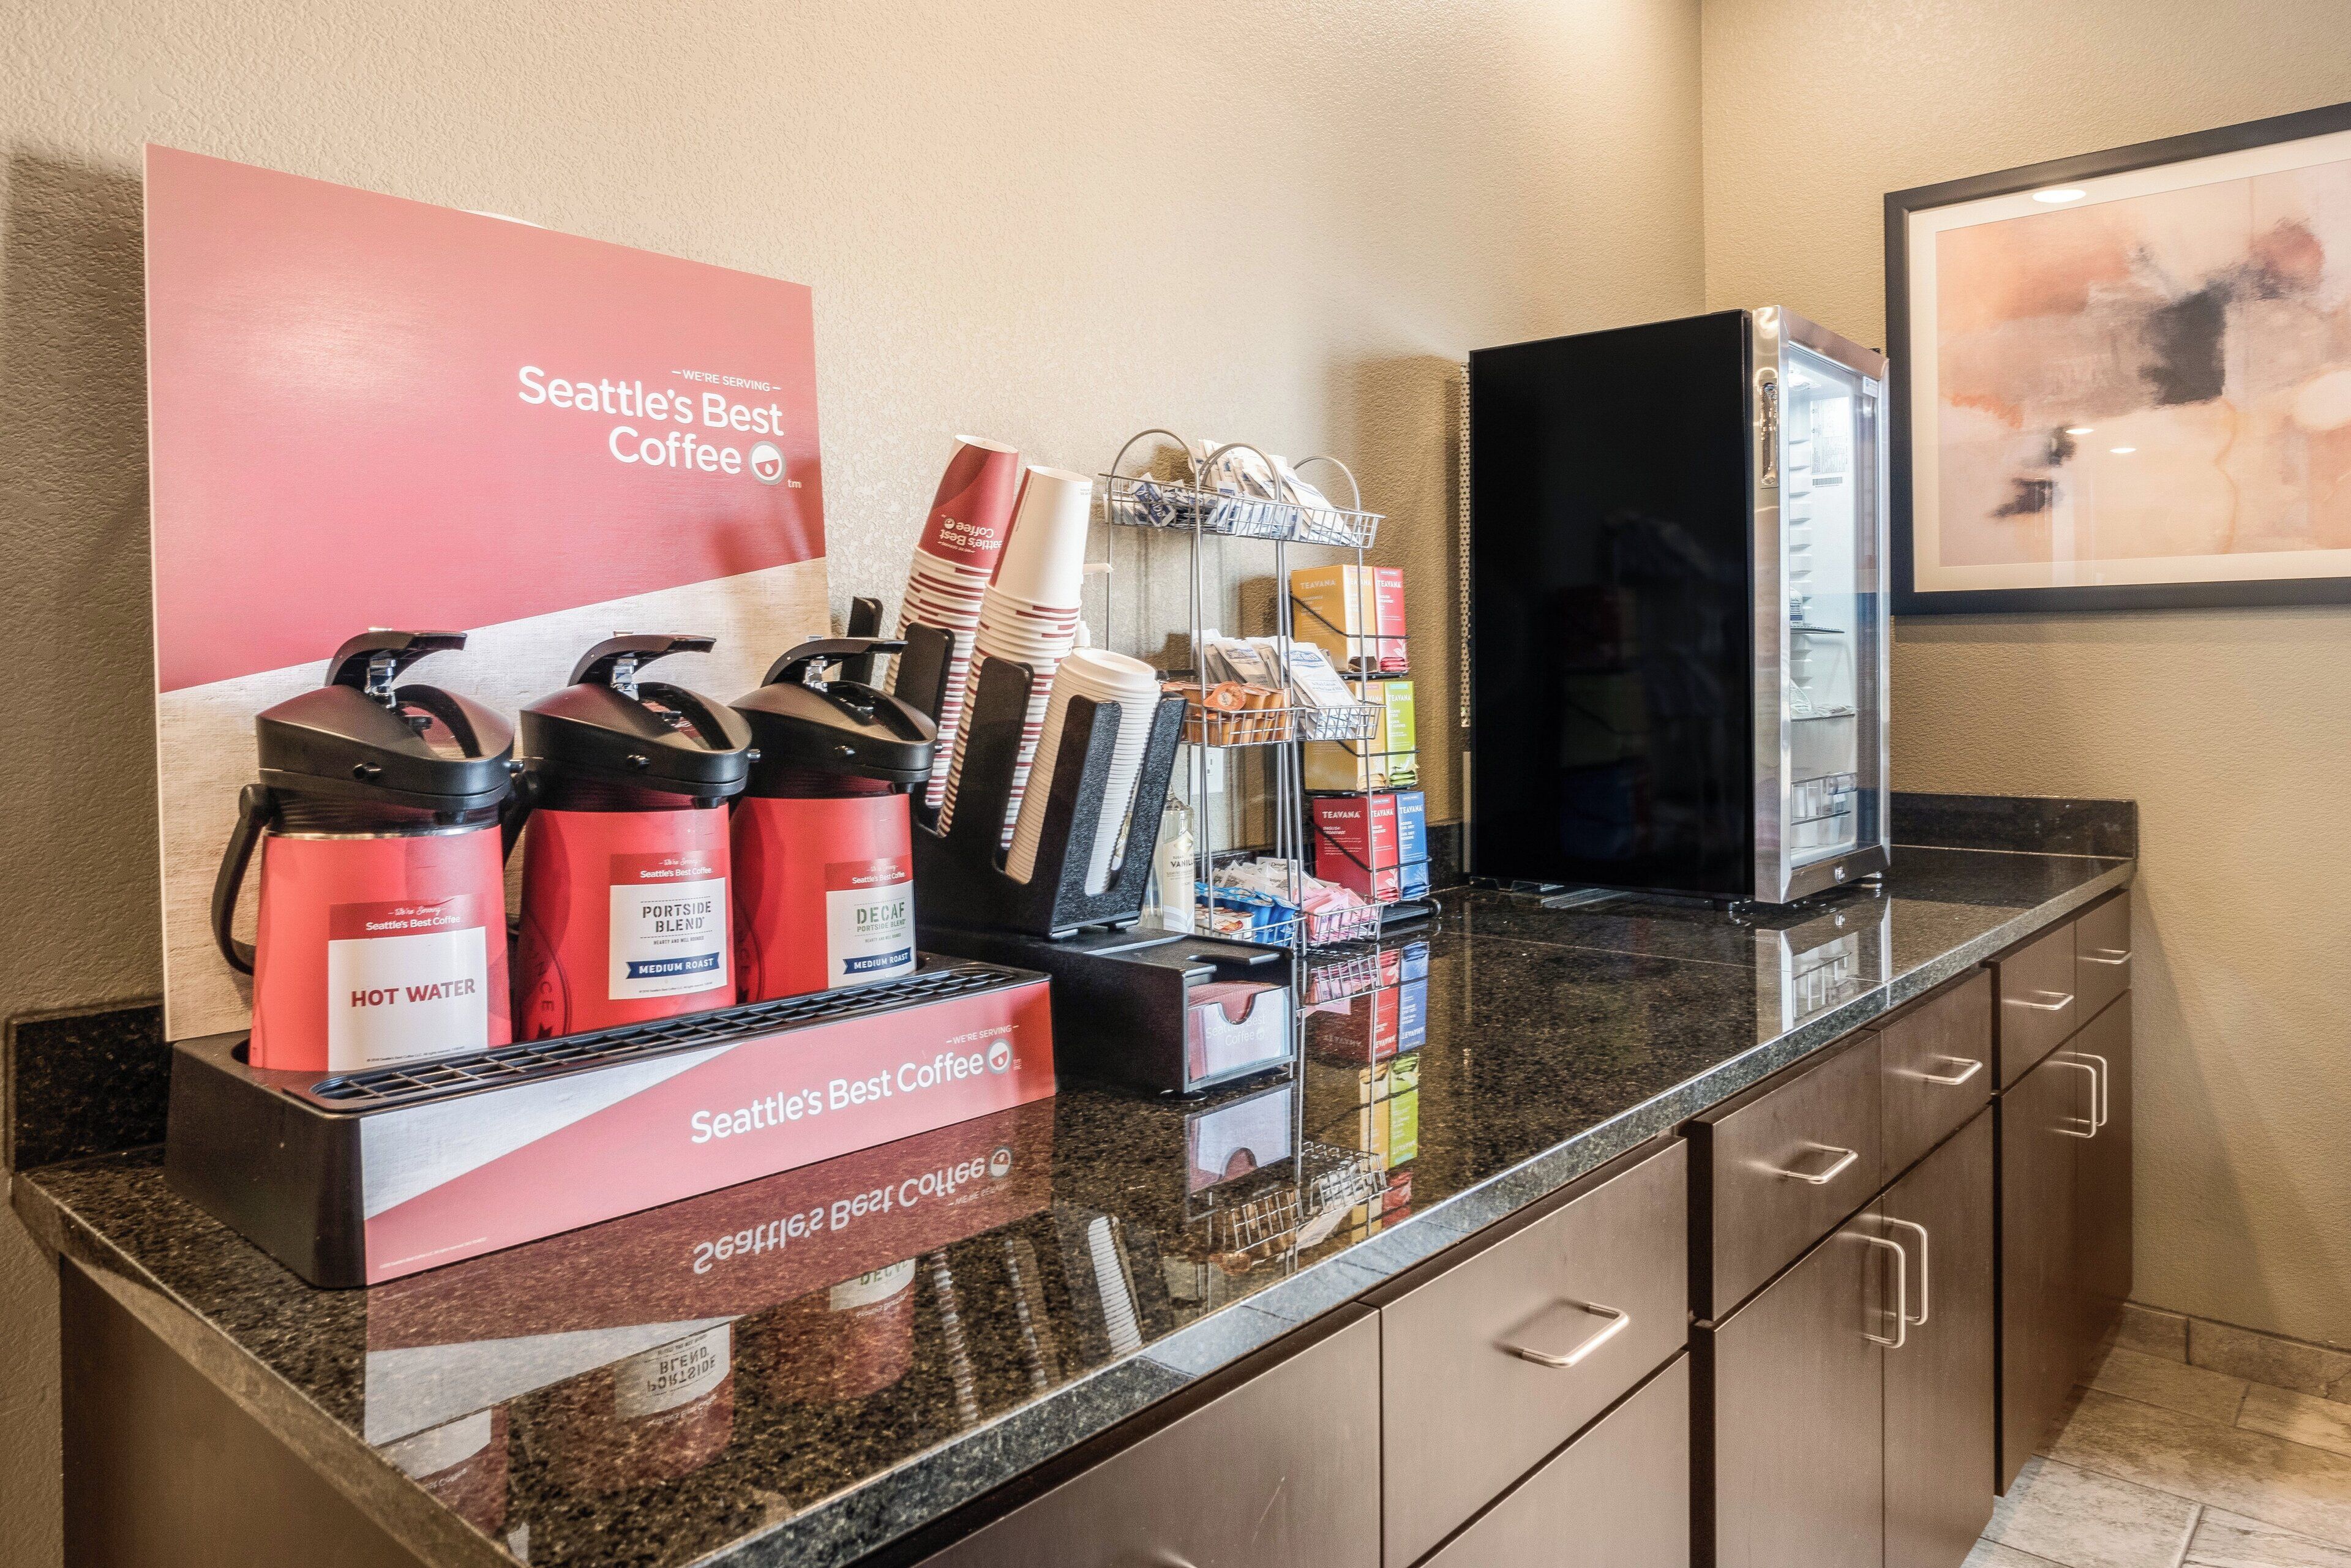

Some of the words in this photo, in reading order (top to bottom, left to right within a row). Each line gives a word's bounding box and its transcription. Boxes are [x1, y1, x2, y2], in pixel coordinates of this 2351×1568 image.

[682, 369, 721, 384] WE'RE
[722, 375, 770, 392] SERVING
[518, 365, 694, 425] Seattle's
[702, 391, 785, 437] Best
[609, 426, 742, 475] Coffee
[939, 529, 967, 546] Best
[956, 522, 994, 538] Coffee
[968, 538, 1002, 550] eattle's
[1300, 579, 1336, 590] TEAVANA
[1378, 580, 1401, 588] TEAVANA
[1322, 811, 1361, 819] TEAVANA
[1399, 805, 1423, 814] TEAVANA
[1171, 859, 1193, 868] VANILL
[643, 901, 711, 918] PORTSIDE
[857, 902, 904, 925] DECAF
[366, 920, 408, 931] Seattle's
[410, 918, 431, 928] Best
[432, 915, 460, 925] Coffee
[656, 917, 703, 932] BLEND
[857, 923, 889, 932] PORTSIDE
[639, 962, 683, 974] MEDIUM
[686, 958, 713, 969] ROAST
[853, 958, 887, 969] MEDIUM
[890, 952, 909, 964] ROAST
[351, 988, 399, 1007] HOT
[406, 978, 475, 1003] WATER
[953, 1032, 978, 1044] WE'RE
[979, 1025, 1013, 1038] SERVING
[1226, 1030, 1254, 1046] Coffee
[691, 1088, 823, 1144] Seattle's
[828, 1066, 892, 1110] Best
[896, 1051, 984, 1092] Coffee
